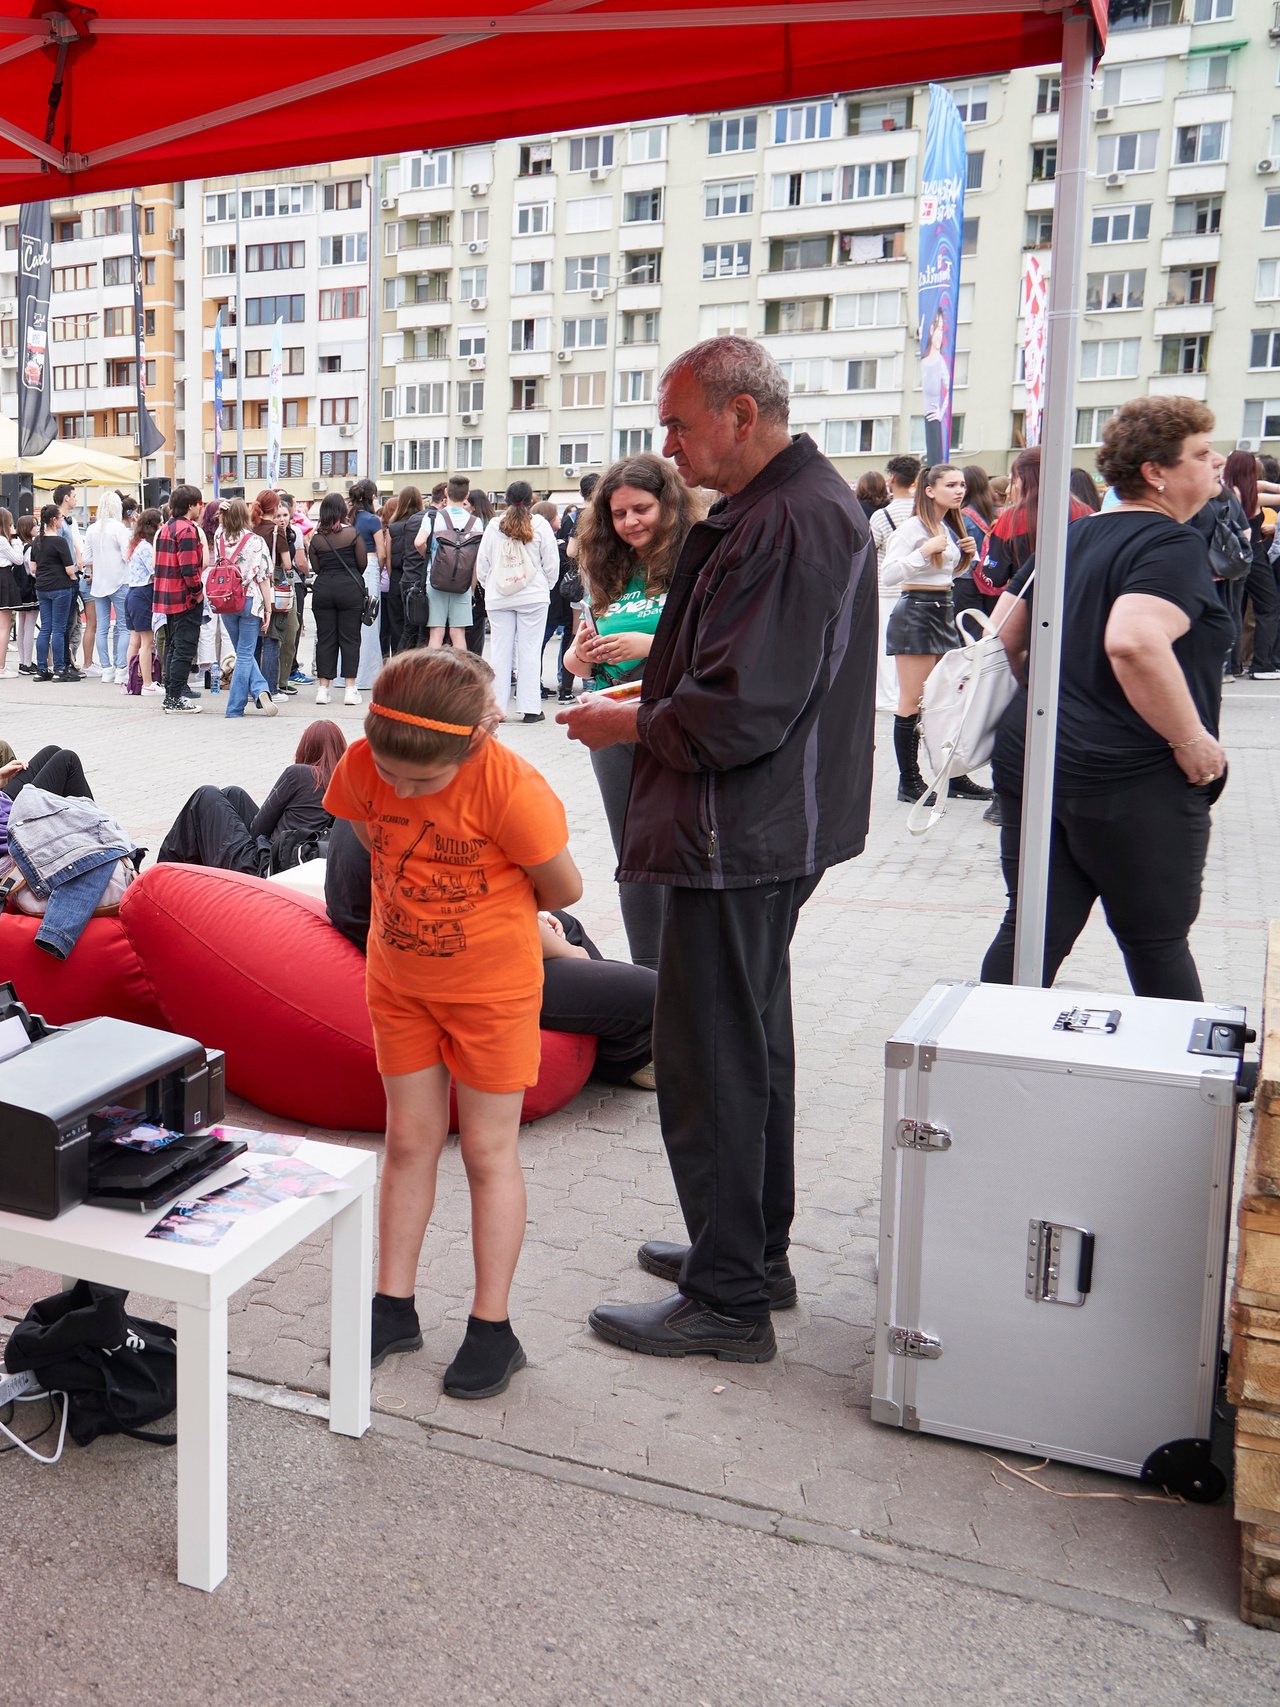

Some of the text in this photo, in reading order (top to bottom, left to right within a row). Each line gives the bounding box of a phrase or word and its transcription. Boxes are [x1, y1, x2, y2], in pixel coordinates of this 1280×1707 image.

[378, 814, 409, 826] EXCAVATOR
[435, 833, 488, 856] BUILDING
[440, 902, 477, 915] TLB LOADER
